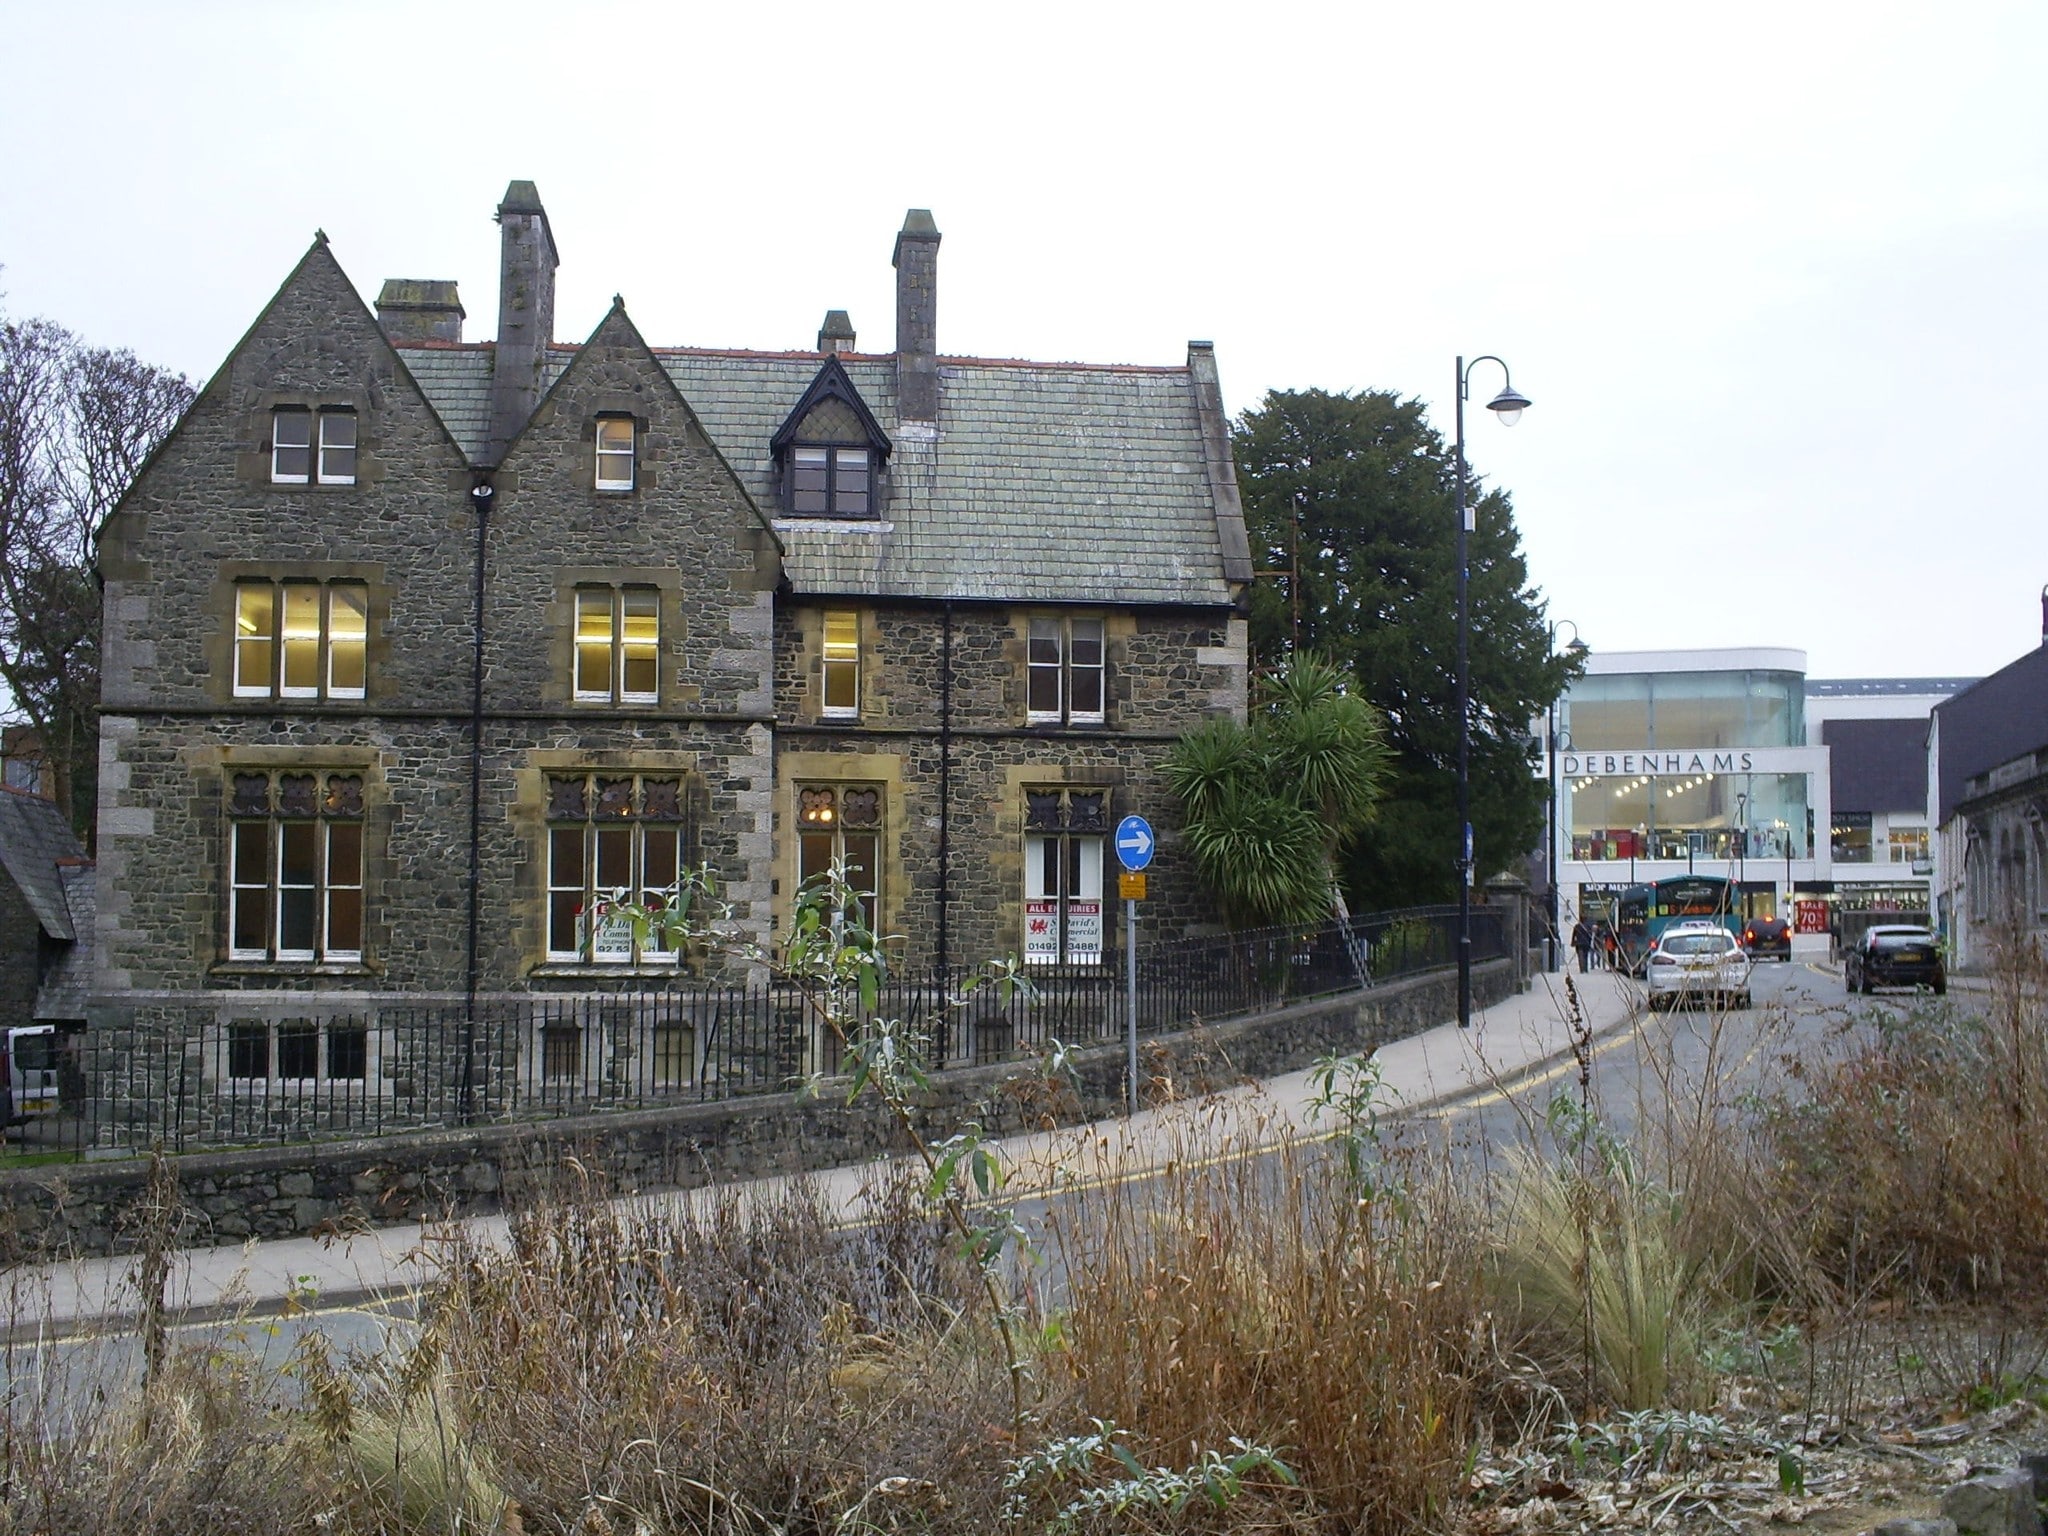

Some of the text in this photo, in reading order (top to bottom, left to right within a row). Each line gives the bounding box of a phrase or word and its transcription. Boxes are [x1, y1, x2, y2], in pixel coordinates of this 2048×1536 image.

[1564, 753, 1752, 773] DEBENHAMS
[1800, 901, 1824, 909] SALE
[1067, 917, 1095, 927] avid's
[1028, 943, 1099, 951] 01492 34881
